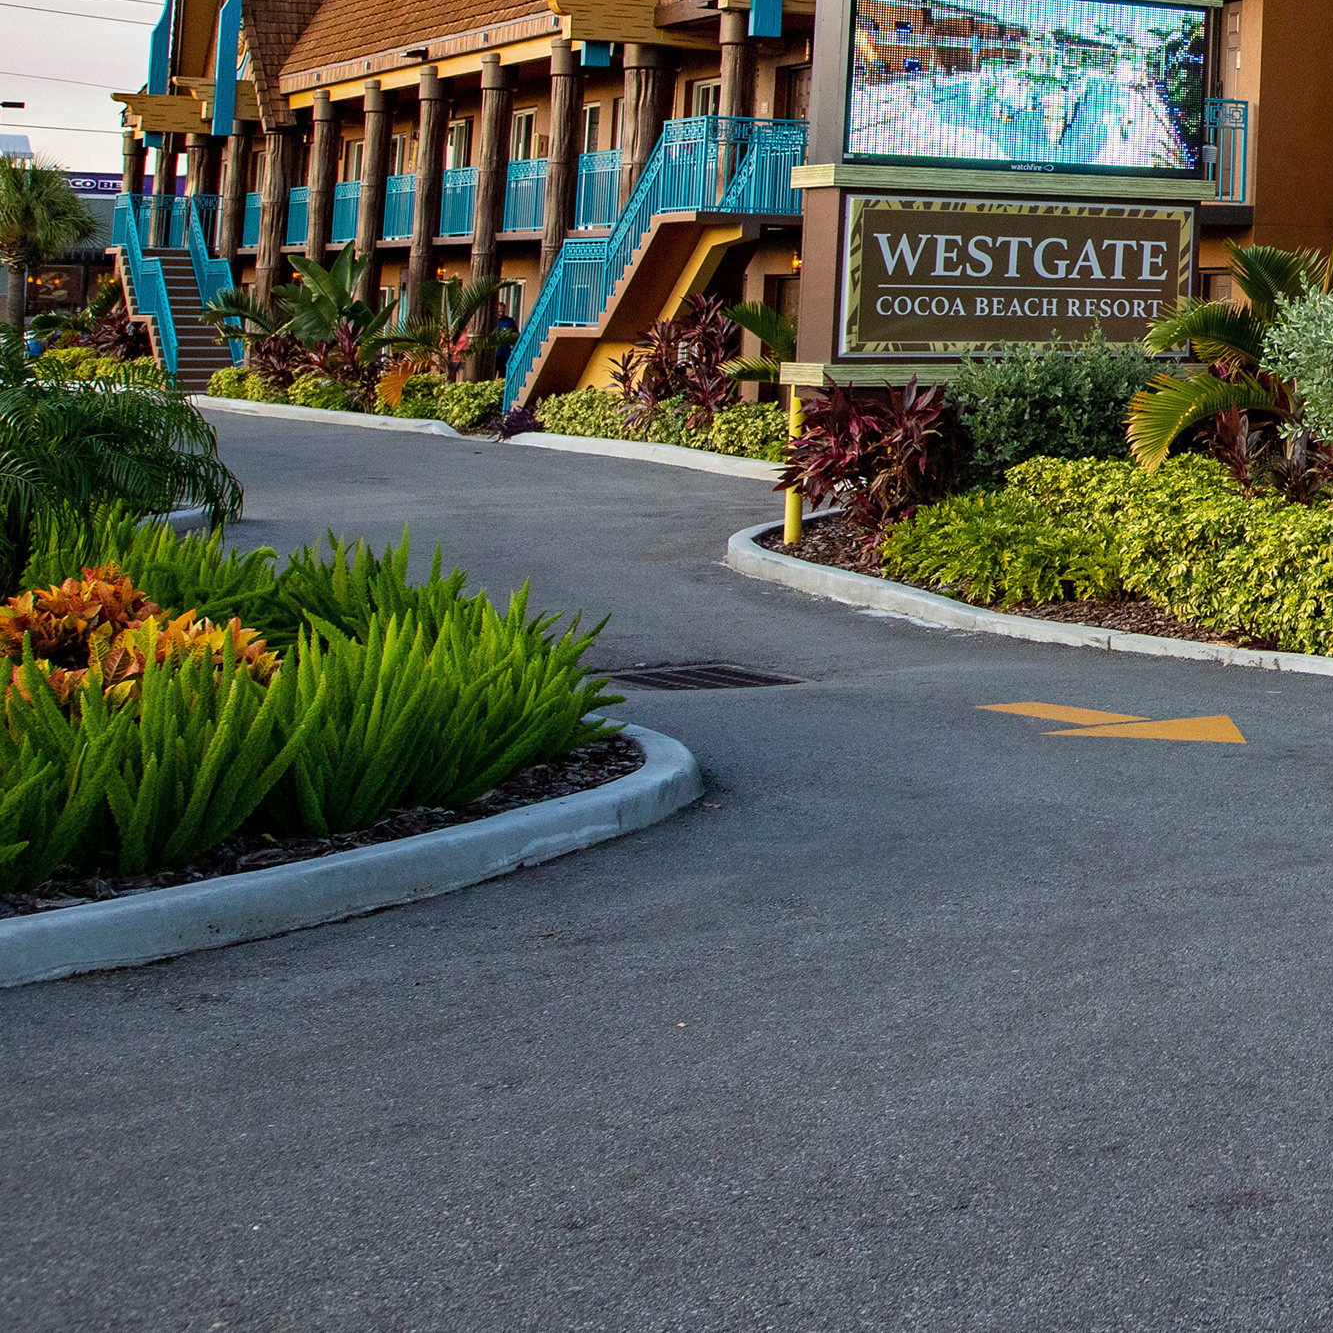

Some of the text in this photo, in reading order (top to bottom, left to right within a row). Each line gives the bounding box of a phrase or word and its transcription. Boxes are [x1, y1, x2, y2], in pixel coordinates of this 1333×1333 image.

[1010, 163, 1042, 171] watchfire
[873, 233, 1168, 281] WESTGATE
[876, 296, 1164, 318] COCOA BEACH RESORT
